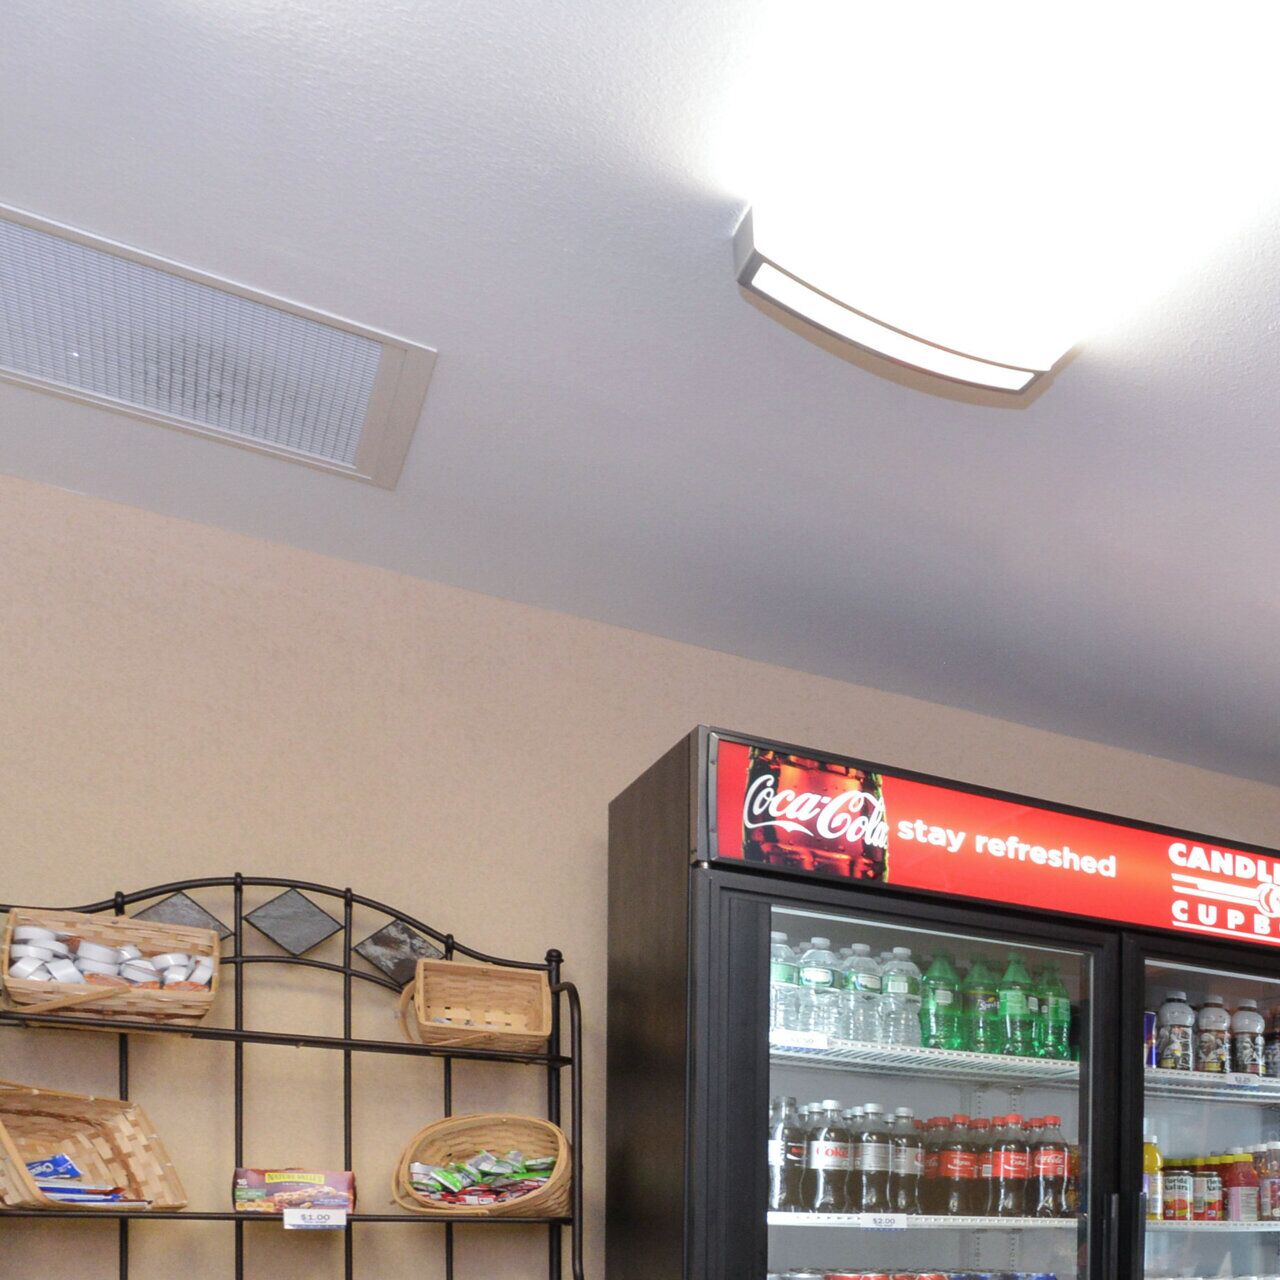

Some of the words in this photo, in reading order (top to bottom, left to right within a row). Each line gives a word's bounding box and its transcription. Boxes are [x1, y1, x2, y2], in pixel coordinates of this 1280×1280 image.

[744, 774, 888, 849] Coca-Cola
[898, 819, 966, 852] stay
[975, 832, 1116, 878] refreshed
[300, 1213, 331, 1222] $1.00
[872, 1217, 896, 1225] $2.00
